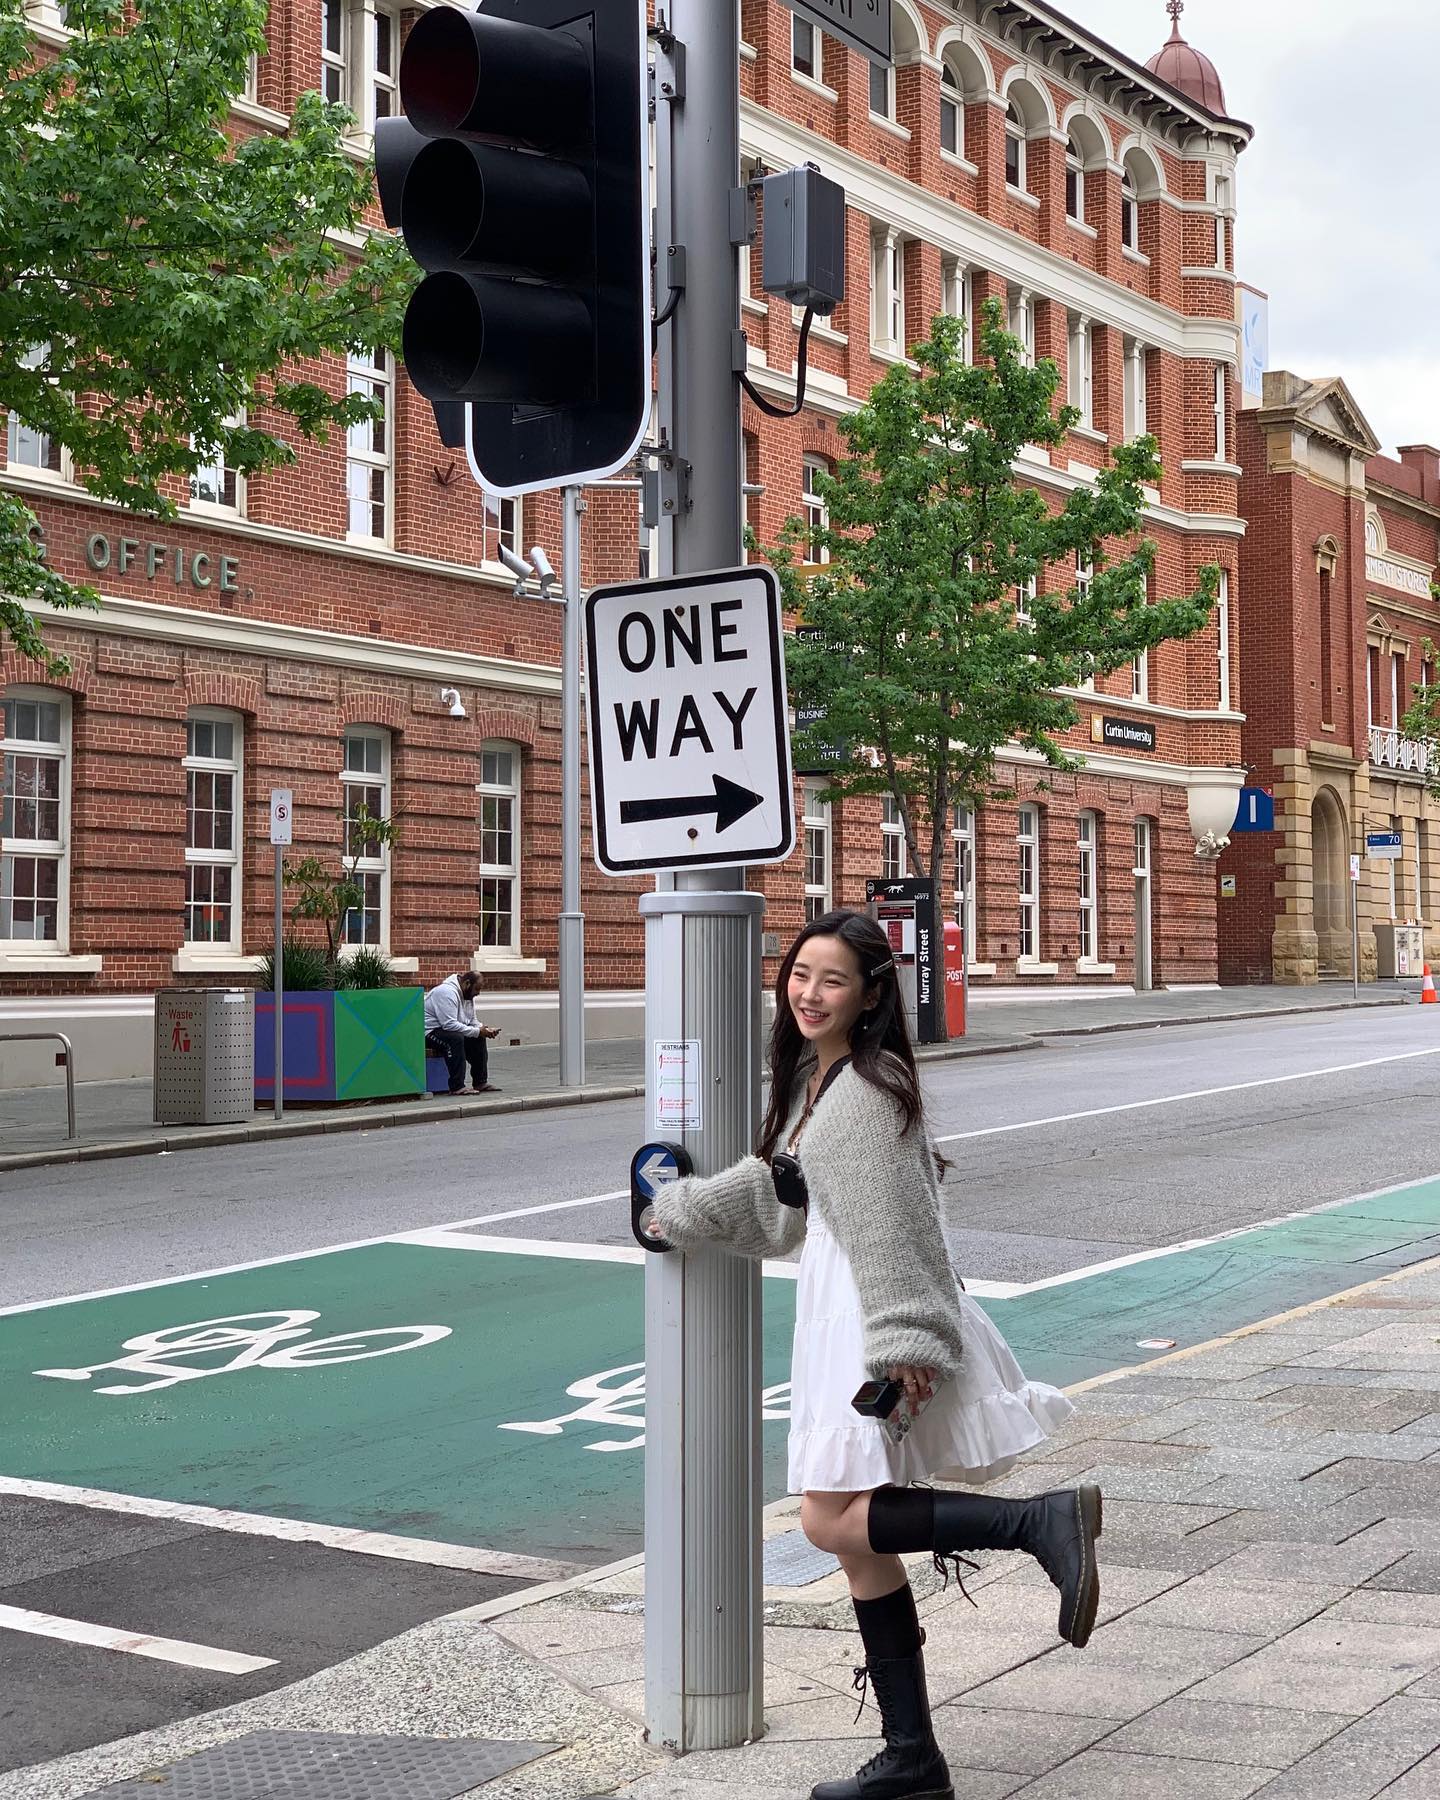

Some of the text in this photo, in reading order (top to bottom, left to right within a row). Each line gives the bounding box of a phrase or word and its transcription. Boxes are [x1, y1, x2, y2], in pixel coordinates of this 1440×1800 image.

[87, 533, 240, 593] OFFICE
[618, 599, 748, 673] ONE
[613, 687, 758, 762] WAY
[1105, 723, 1152, 746] Curtin University
[1388, 835, 1400, 844] 70
[919, 928, 931, 1004] Murray Street
[946, 970, 963, 981] POST
[168, 1009, 193, 1020] Waste
